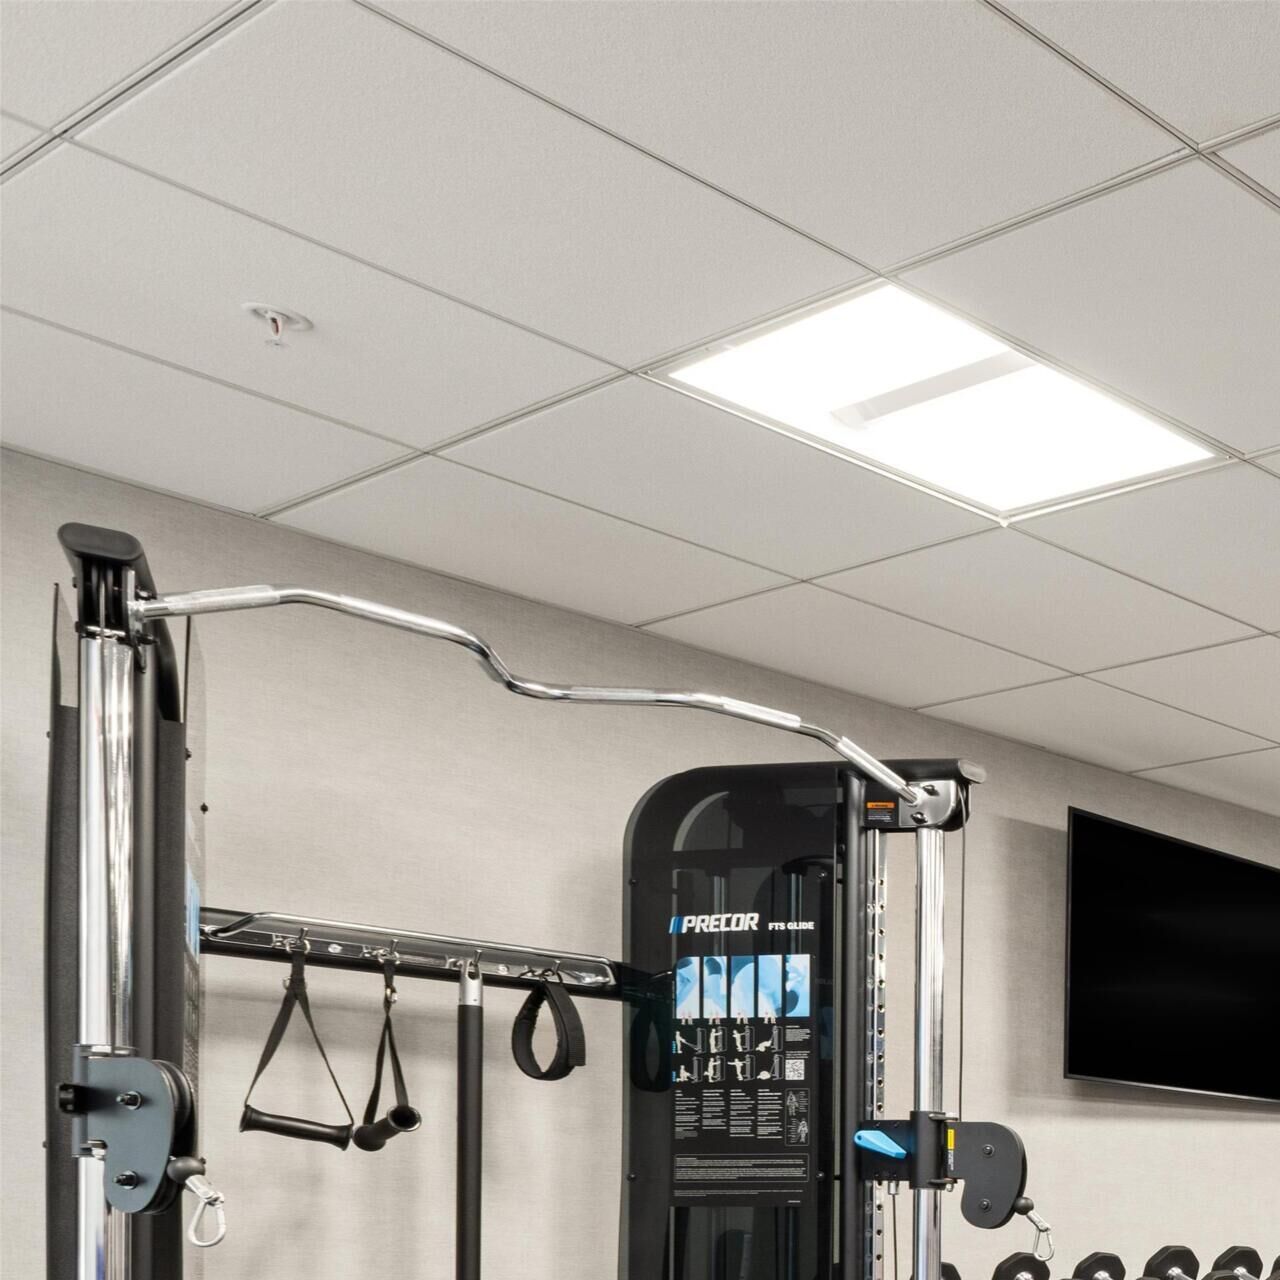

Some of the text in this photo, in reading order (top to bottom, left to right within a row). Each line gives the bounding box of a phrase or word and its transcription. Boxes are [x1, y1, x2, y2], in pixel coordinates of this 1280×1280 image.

[680, 912, 815, 933] PRECOR FTS GLIDE
